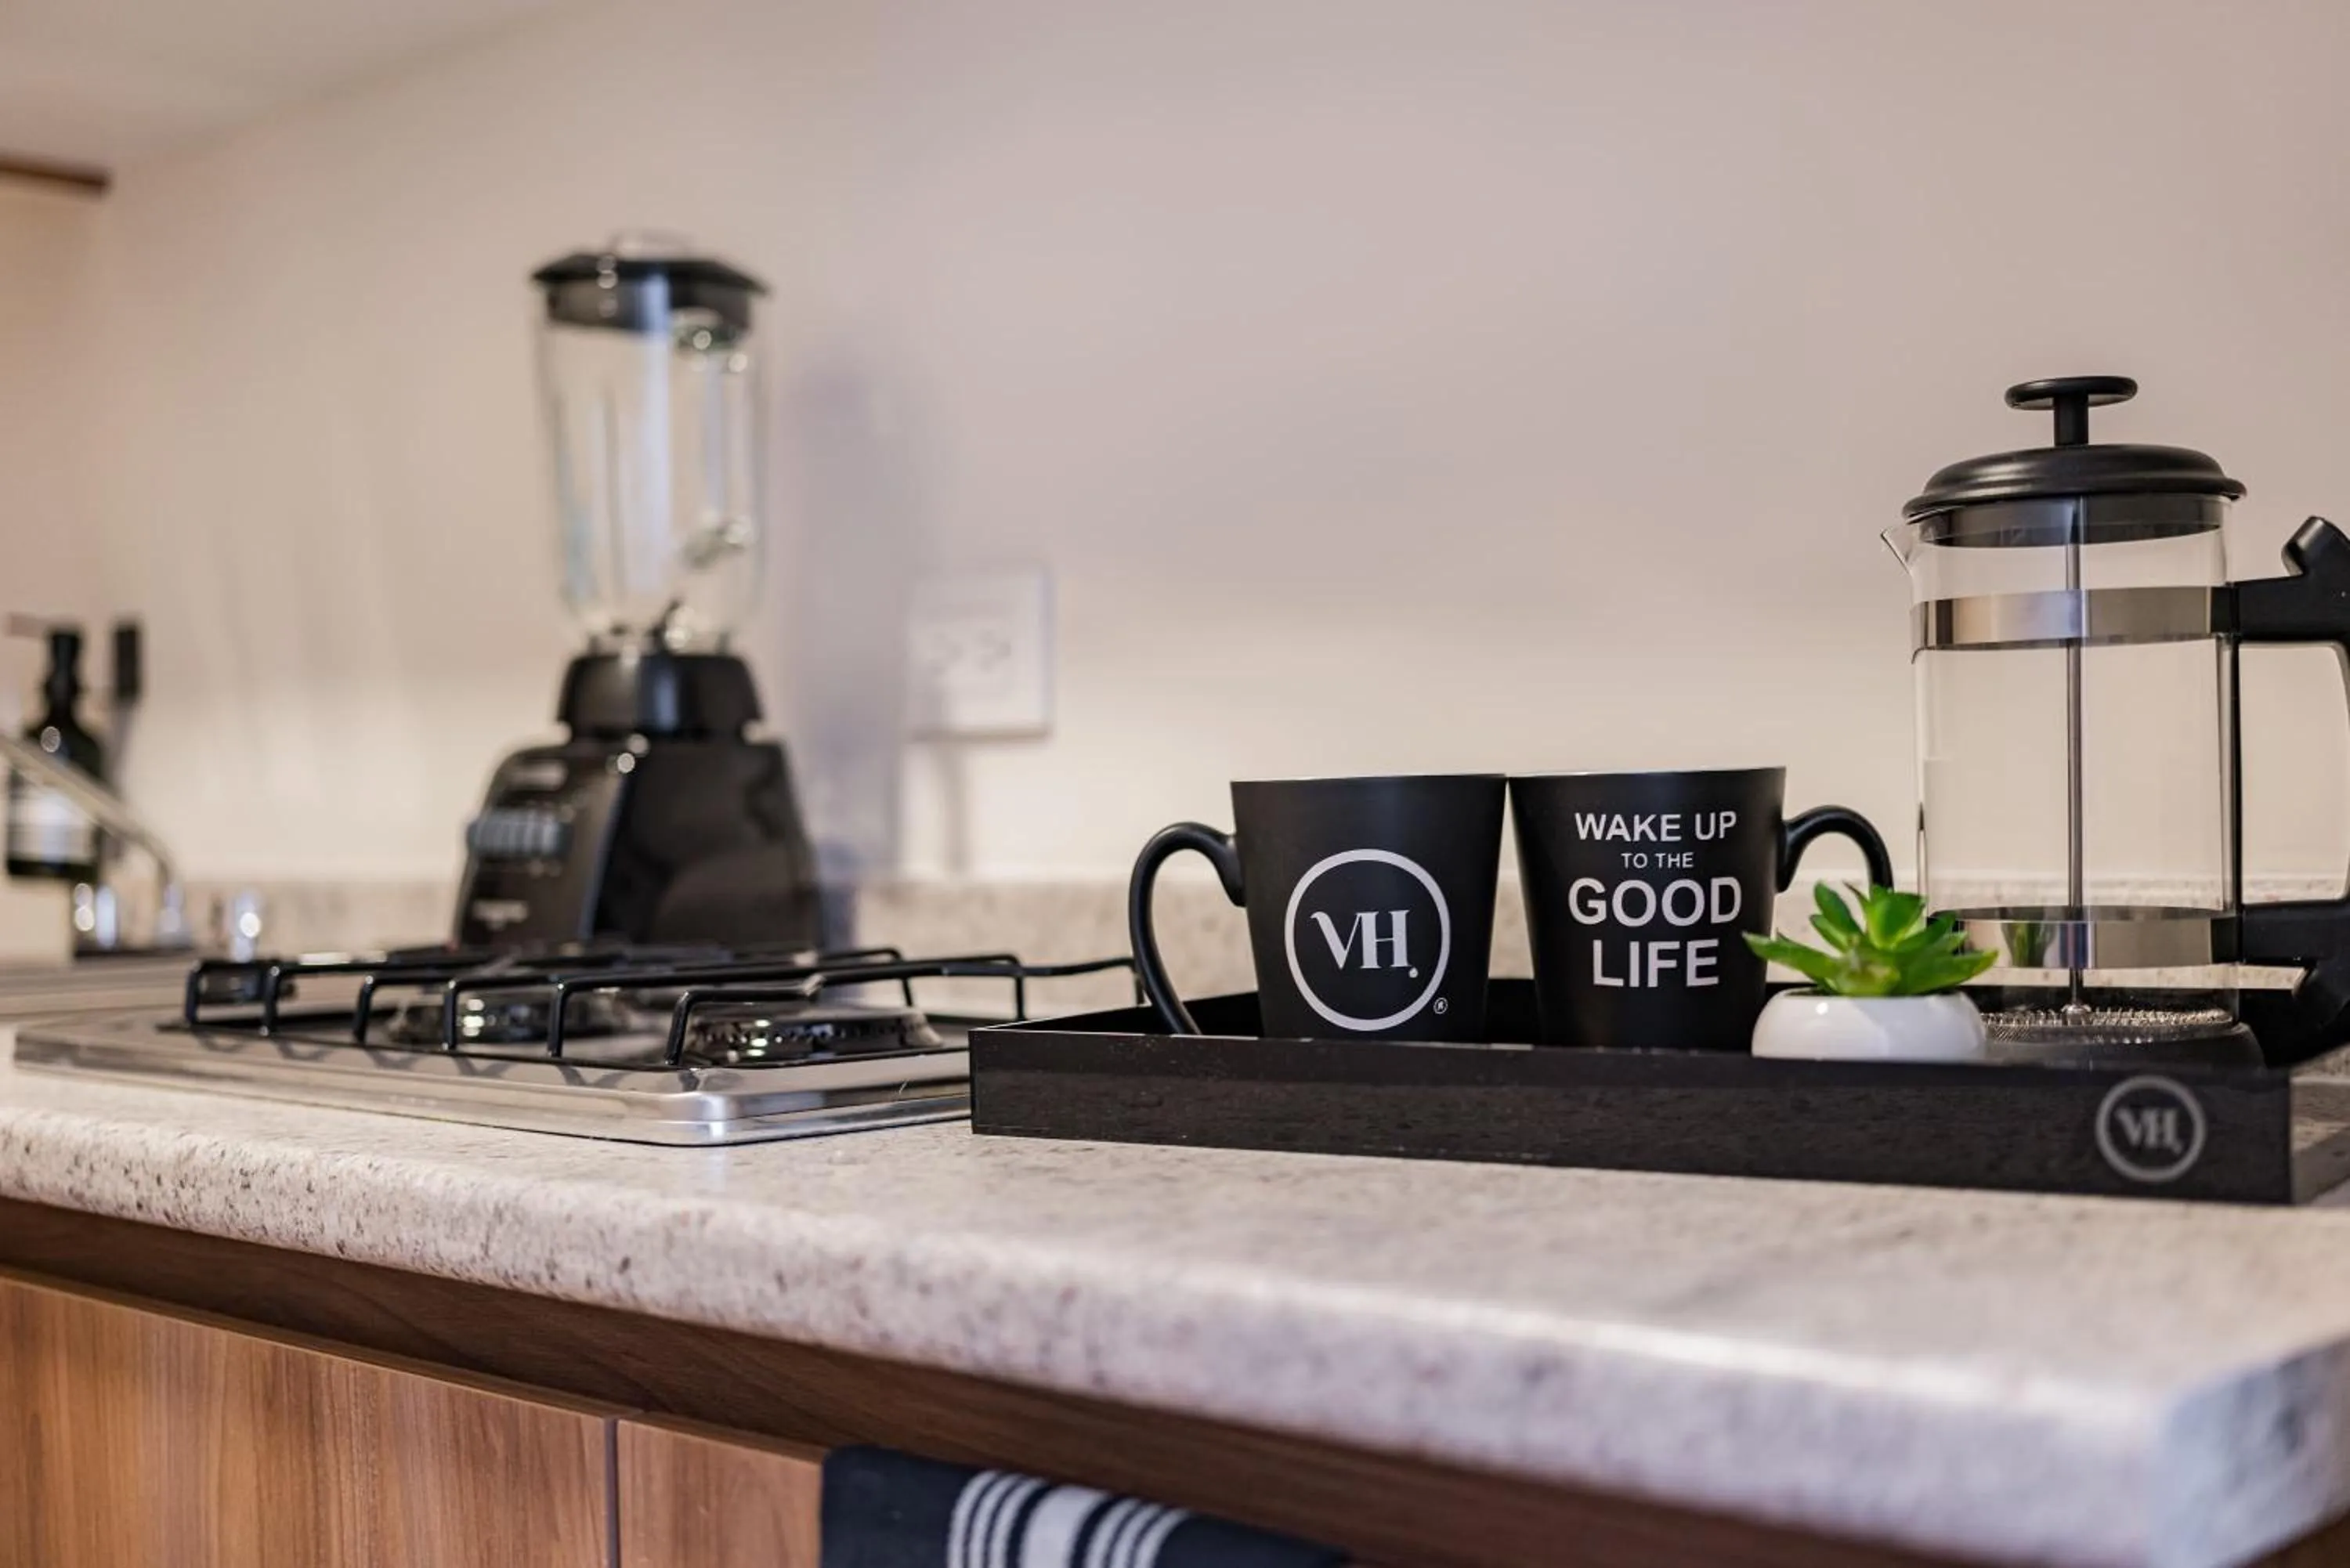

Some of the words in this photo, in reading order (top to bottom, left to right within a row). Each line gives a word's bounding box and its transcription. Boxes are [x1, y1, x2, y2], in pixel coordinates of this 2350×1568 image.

[1574, 812, 1682, 842] WAKE
[1695, 811, 1737, 840] UP
[1621, 853, 1648, 869] TO
[1654, 851, 1693, 869] THE
[1568, 876, 1741, 927] GOOD
[1593, 939, 1719, 988] LIFE
